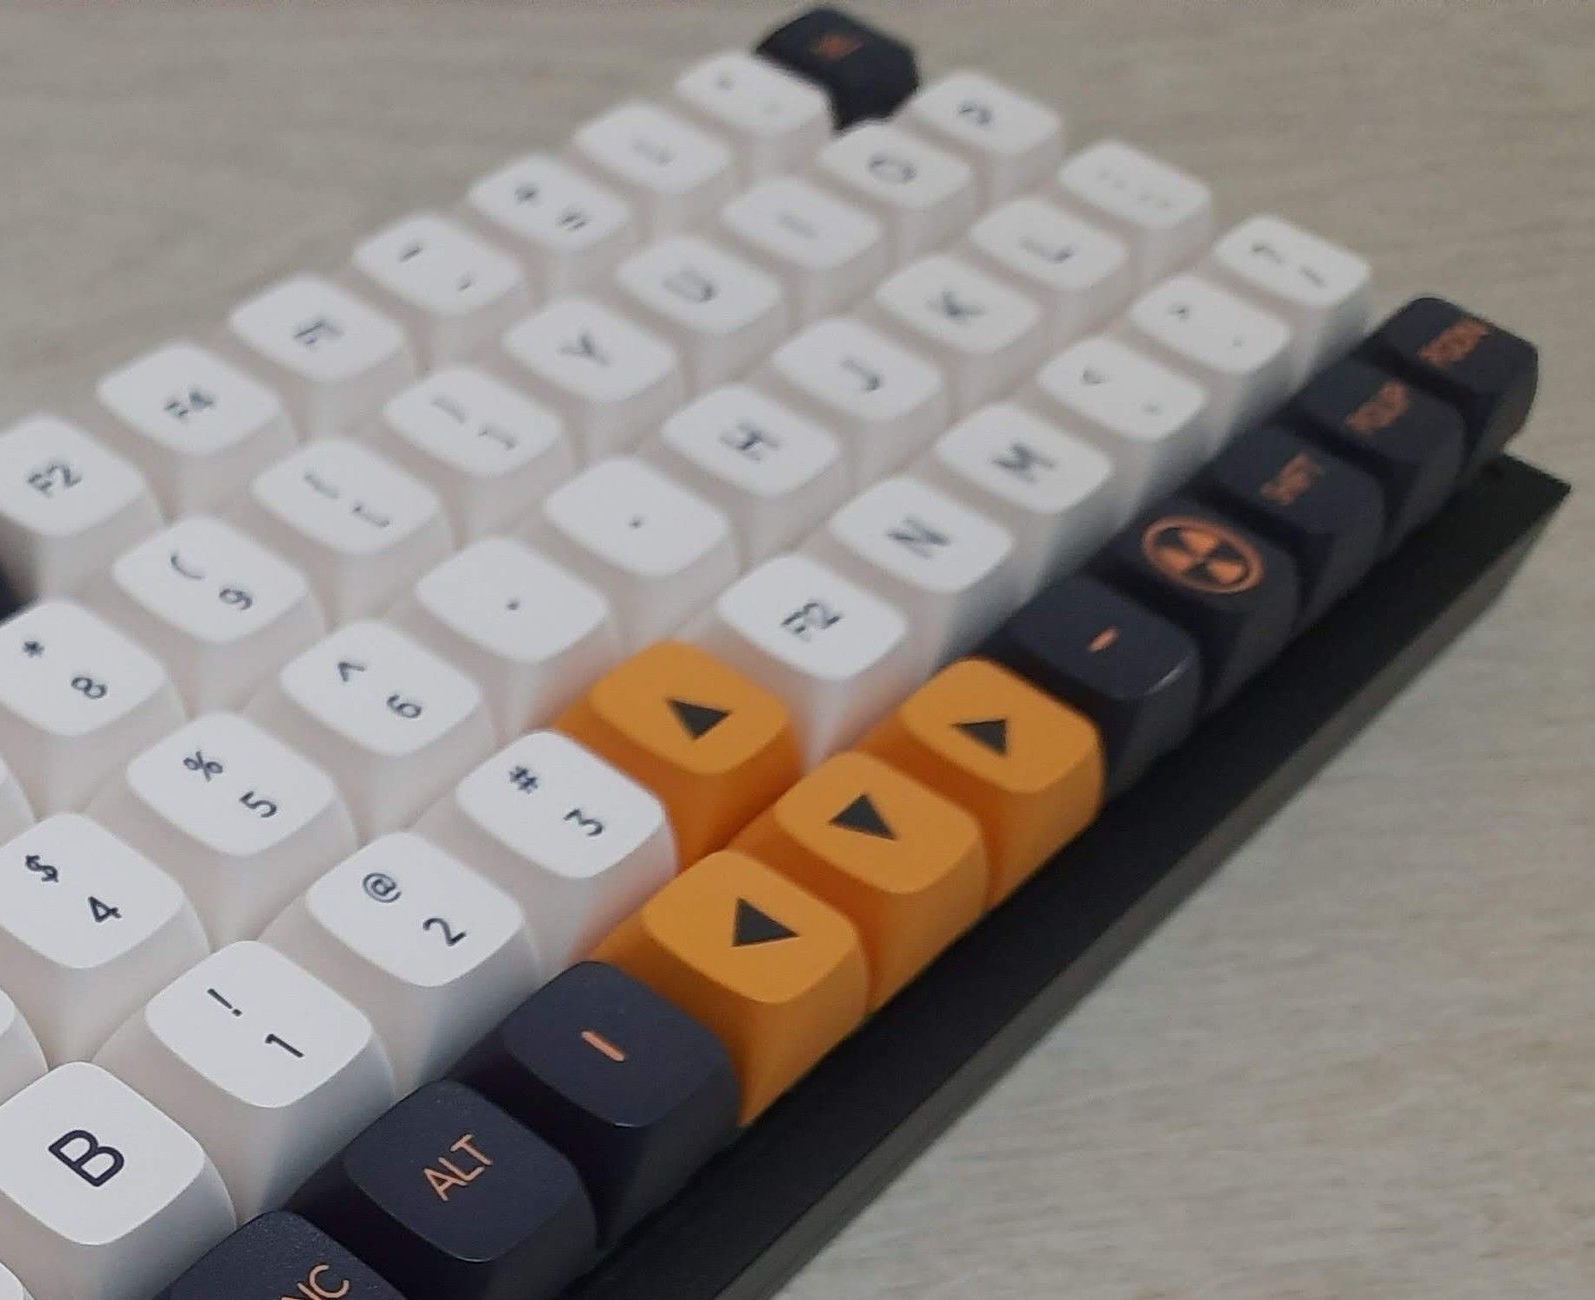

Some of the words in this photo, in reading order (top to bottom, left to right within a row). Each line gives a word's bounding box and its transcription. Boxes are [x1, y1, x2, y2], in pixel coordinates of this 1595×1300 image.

[929, 287, 985, 323] K
[558, 331, 610, 368] Y
[720, 420, 779, 460] H
[992, 443, 1055, 482] M
[24, 460, 85, 499] F2
[886, 518, 951, 558] N
[218, 587, 254, 611] 9
[779, 599, 844, 643] F2
[70, 675, 108, 700] 8
[386, 693, 423, 719] 6
[182, 750, 224, 782] %
[509, 766, 538, 793] #
[239, 790, 278, 819] 5
[563, 808, 605, 837] 3
[25, 854, 59, 883] $
[362, 872, 402, 904] @
[87, 895, 122, 923] 4
[422, 917, 467, 947] 2
[207, 987, 243, 1017] !
[264, 1033, 304, 1059] 1
[47, 1129, 125, 1188] B
[423, 1133, 493, 1202] ALT
